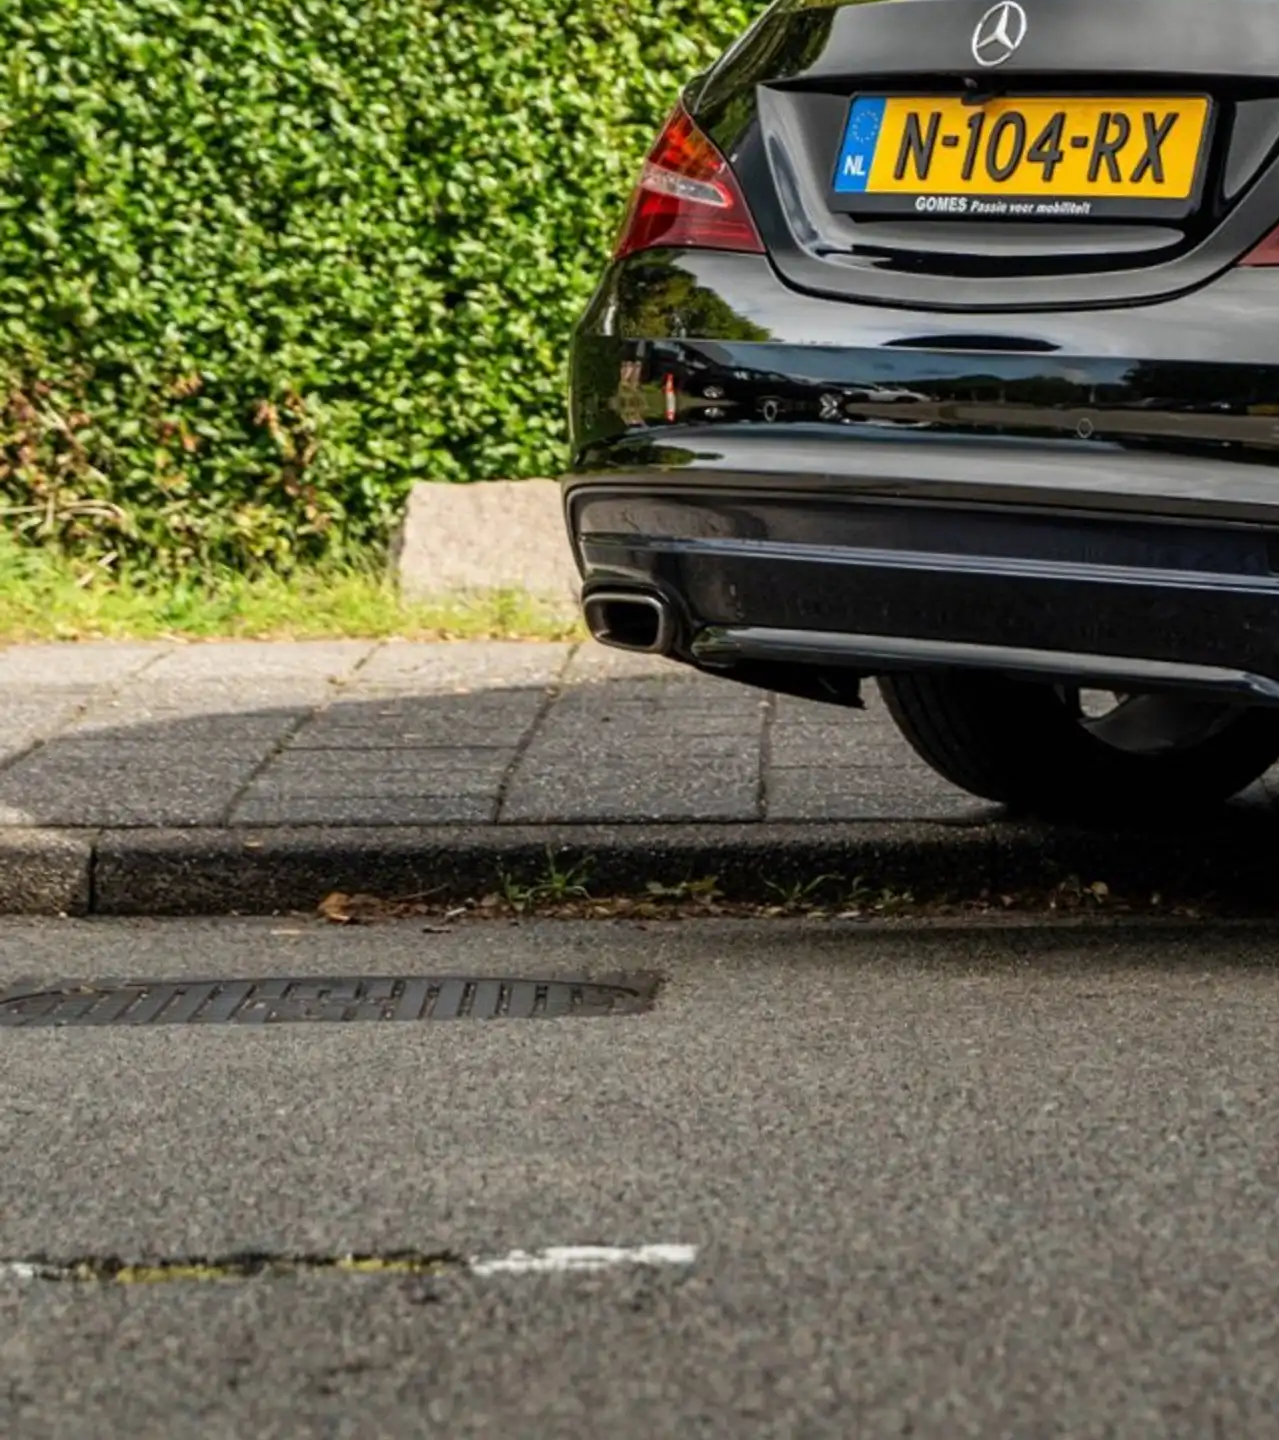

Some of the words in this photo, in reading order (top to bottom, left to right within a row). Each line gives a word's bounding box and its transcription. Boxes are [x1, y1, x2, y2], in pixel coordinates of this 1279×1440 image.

[893, 110, 1180, 184] N-104-RX
[843, 154, 867, 177] NL
[914, 195, 968, 213] GOMES
[970, 200, 1007, 215] Passie
[1009, 202, 1034, 215] voor
